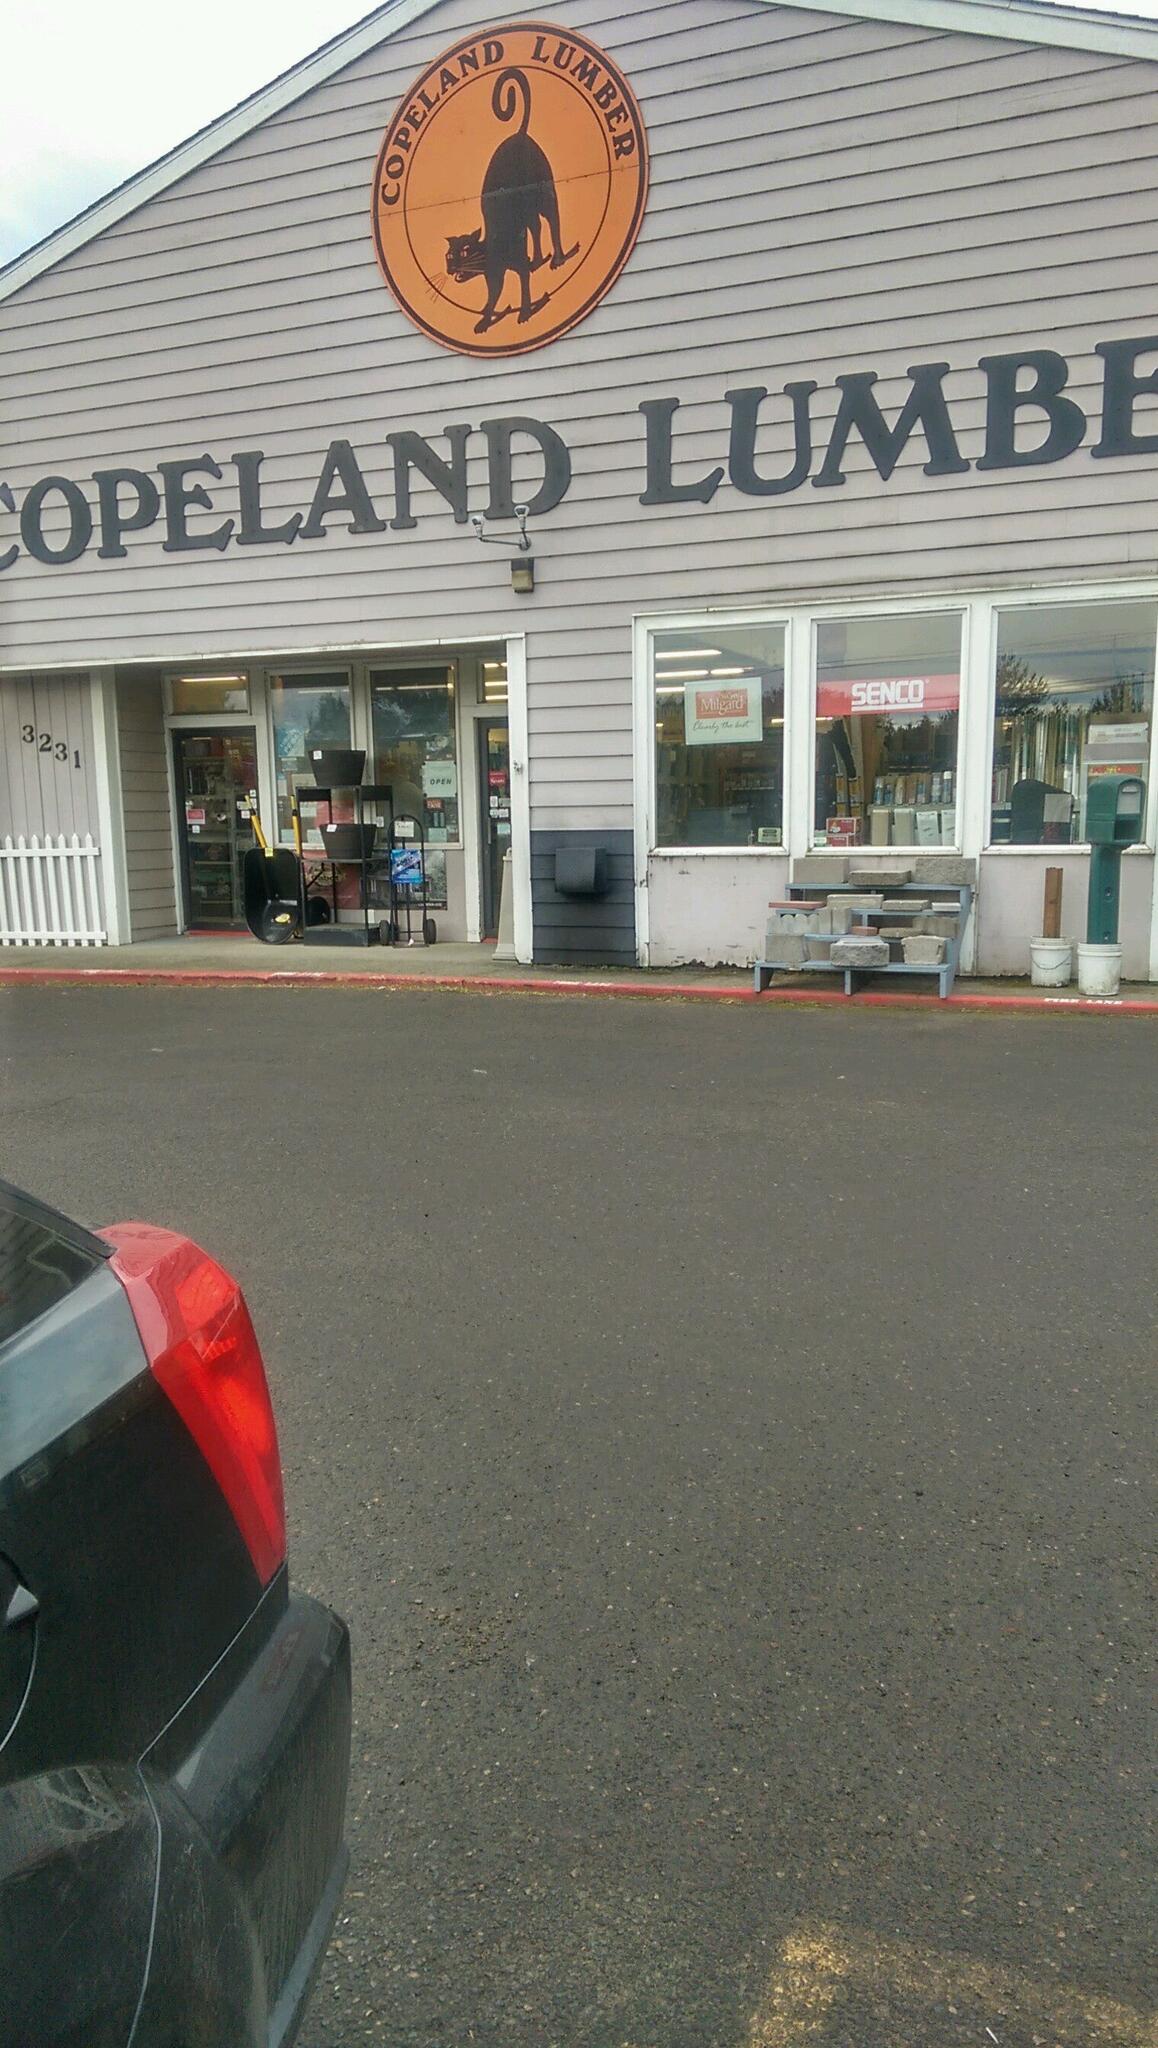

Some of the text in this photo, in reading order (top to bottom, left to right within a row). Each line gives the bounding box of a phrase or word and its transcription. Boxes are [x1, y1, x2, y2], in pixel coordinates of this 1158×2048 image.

[381, 35, 637, 206] COPELAND LUMBER
[701, 694, 745, 716] Milgard
[851, 679, 925, 706] SENCO
[22, 724, 81, 769] 3231
